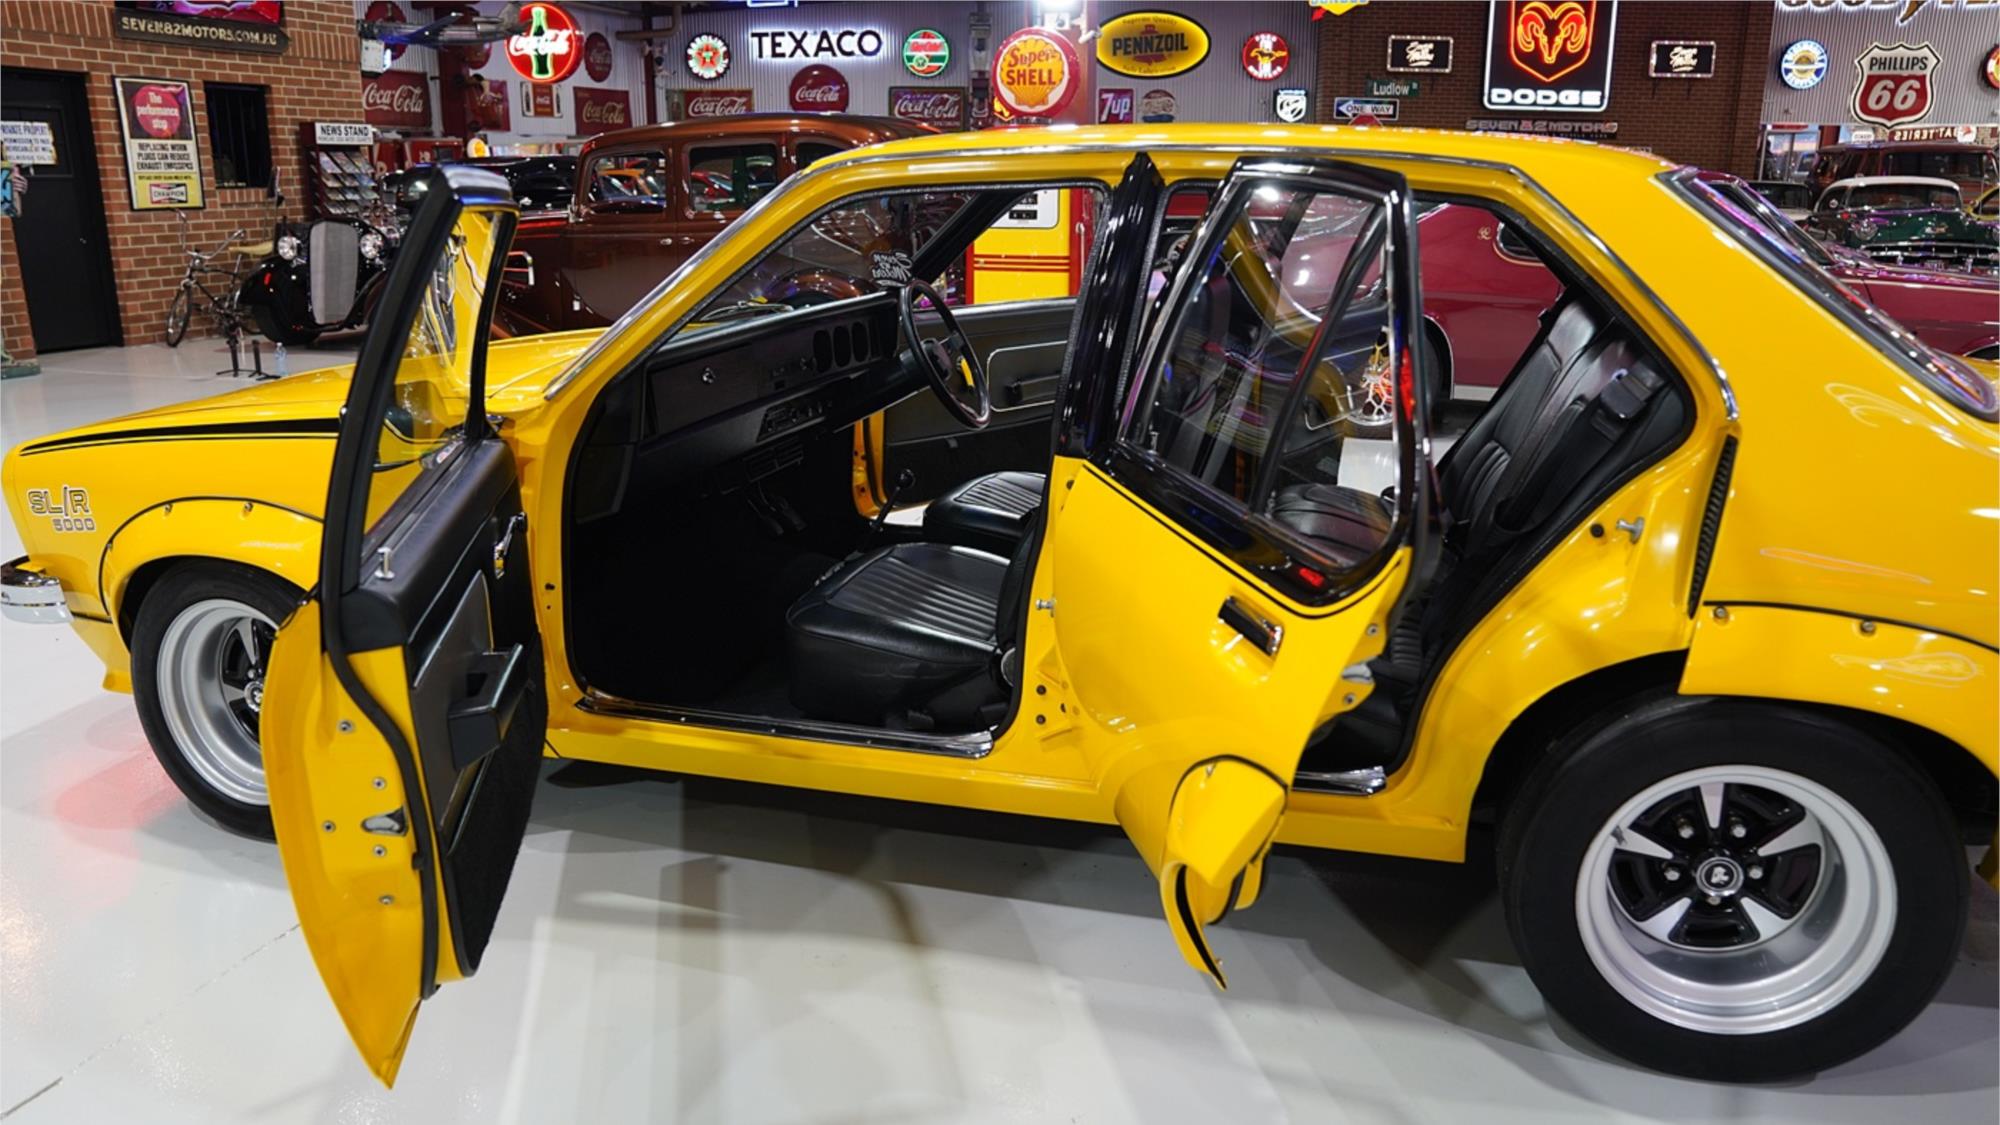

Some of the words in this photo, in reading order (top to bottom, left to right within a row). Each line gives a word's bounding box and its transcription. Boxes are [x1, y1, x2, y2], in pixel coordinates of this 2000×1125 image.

[121, 16, 277, 46] SEVEN82MOTORS.COM.AU
[750, 29, 883, 59] TEXACO
[1111, 32, 1189, 57] PENNZOIL
[1869, 56, 1929, 71] PHILLIPS
[1005, 68, 1057, 86] SHELL
[362, 82, 424, 113] Coca-Cola
[1373, 81, 1410, 96] Ludlow
[1490, 87, 1603, 106] DODGE
[1867, 79, 1921, 111] 66
[1100, 92, 1131, 123] 7up
[1371, 104, 1391, 113] WAY
[320, 125, 343, 136] NEWS
[343, 126, 370, 137] STAND
[157, 152, 169, 161] CAN
[153, 190, 185, 199] CHAMPION
[27, 485, 90, 518] SL/R
[51, 517, 96, 532] 5000
